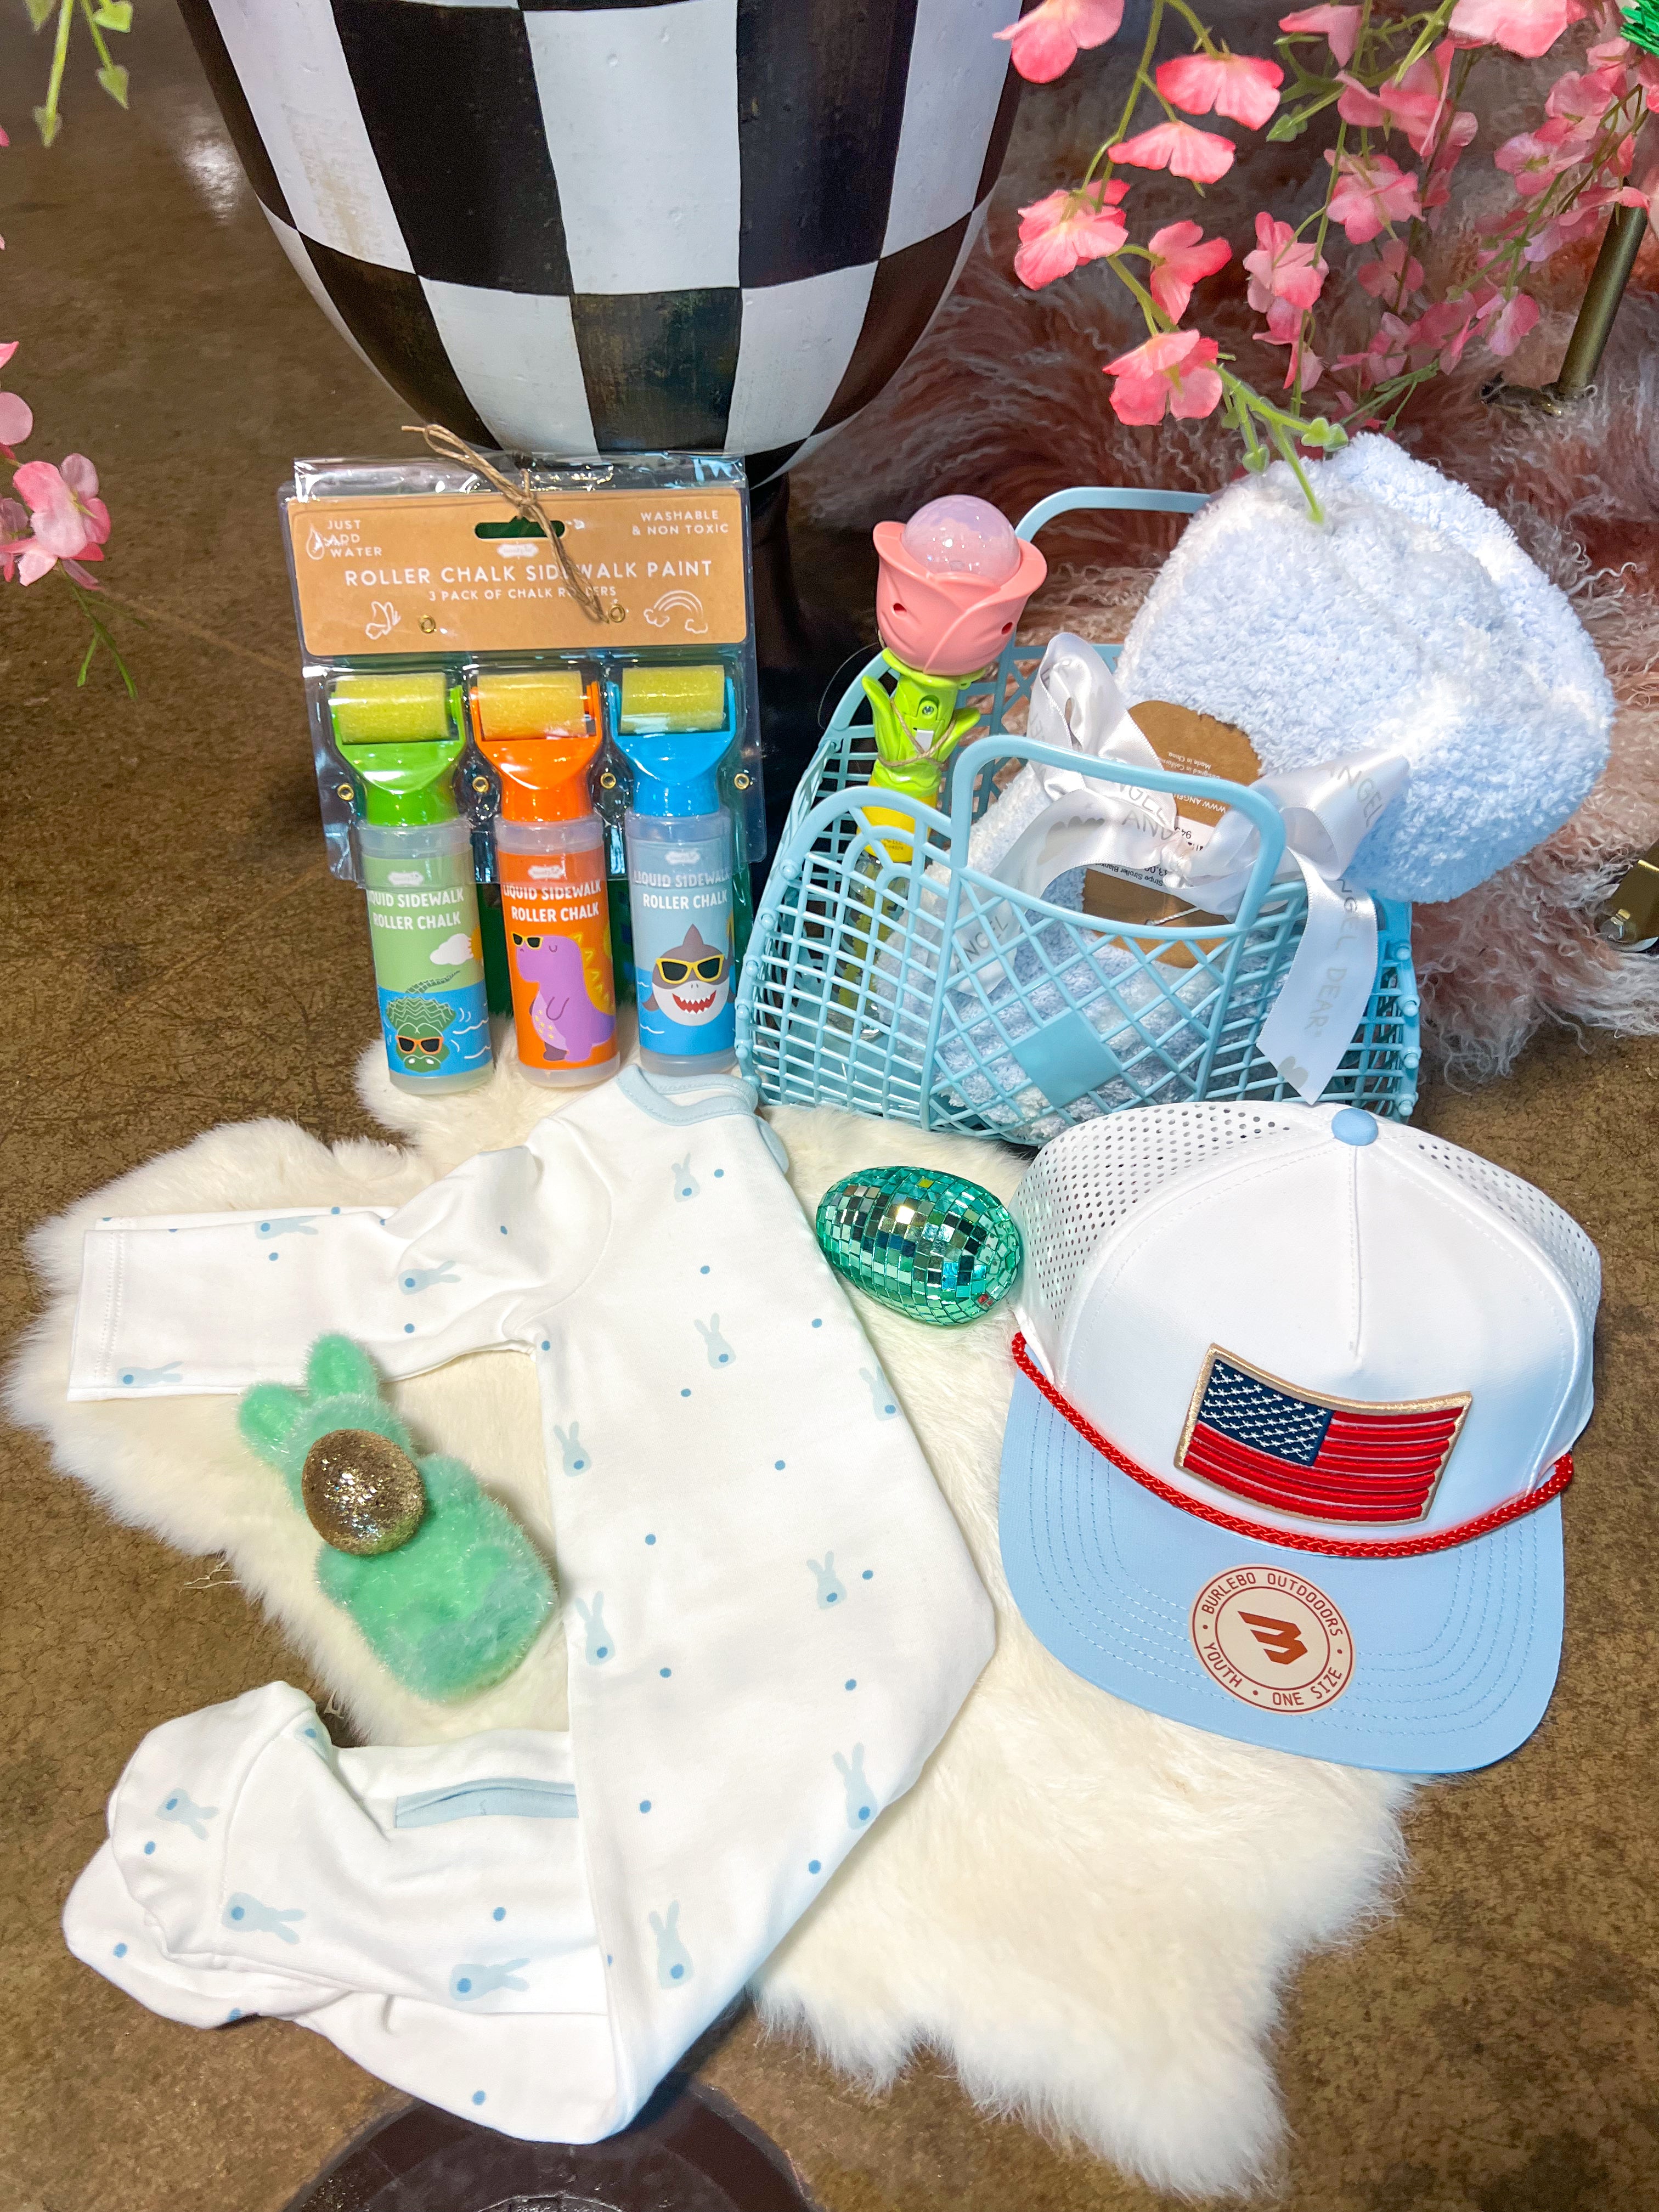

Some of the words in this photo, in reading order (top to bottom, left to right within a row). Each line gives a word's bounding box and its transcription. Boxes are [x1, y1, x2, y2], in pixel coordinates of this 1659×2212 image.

[327, 520, 362, 530] JUST
[641, 510, 719, 521] WASHABLE
[329, 534, 360, 544] ADD
[632, 525, 641, 535] &
[648, 524, 679, 535] NON
[686, 523, 729, 534] TOXIC
[330, 546, 382, 558] WATER
[345, 567, 431, 586] ROLLER
[441, 565, 516, 583] CHALK
[526, 561, 637, 582] SIDWALK
[647, 560, 712, 578] PAINT
[429, 590, 436, 601] 3
[441, 590, 479, 601] PACK
[484, 589, 502, 600] OF
[508, 587, 553, 599] CHALK
[1194, 760, 1211, 771] Made
[634, 870, 672, 888] LIQUID
[675, 867, 730, 888] SIDEWALK
[397, 887, 464, 908] SIDEWALK
[503, 884, 538, 901] LIQUID
[541, 879, 601, 900] SIDEWALK
[642, 893, 690, 910] ROLLER
[693, 889, 727, 909] CHALK
[373, 912, 414, 930] ROLLER
[417, 911, 461, 930] CHALK
[511, 905, 557, 922] ROLLER
[560, 901, 600, 922] CHALK
[1201, 1572, 1256, 1615] BURLEBO
[1204, 1642, 1243, 1688] YOUTH
[1272, 1692, 1305, 1706] ONE
[1310, 1667, 1342, 1700] SIZE
